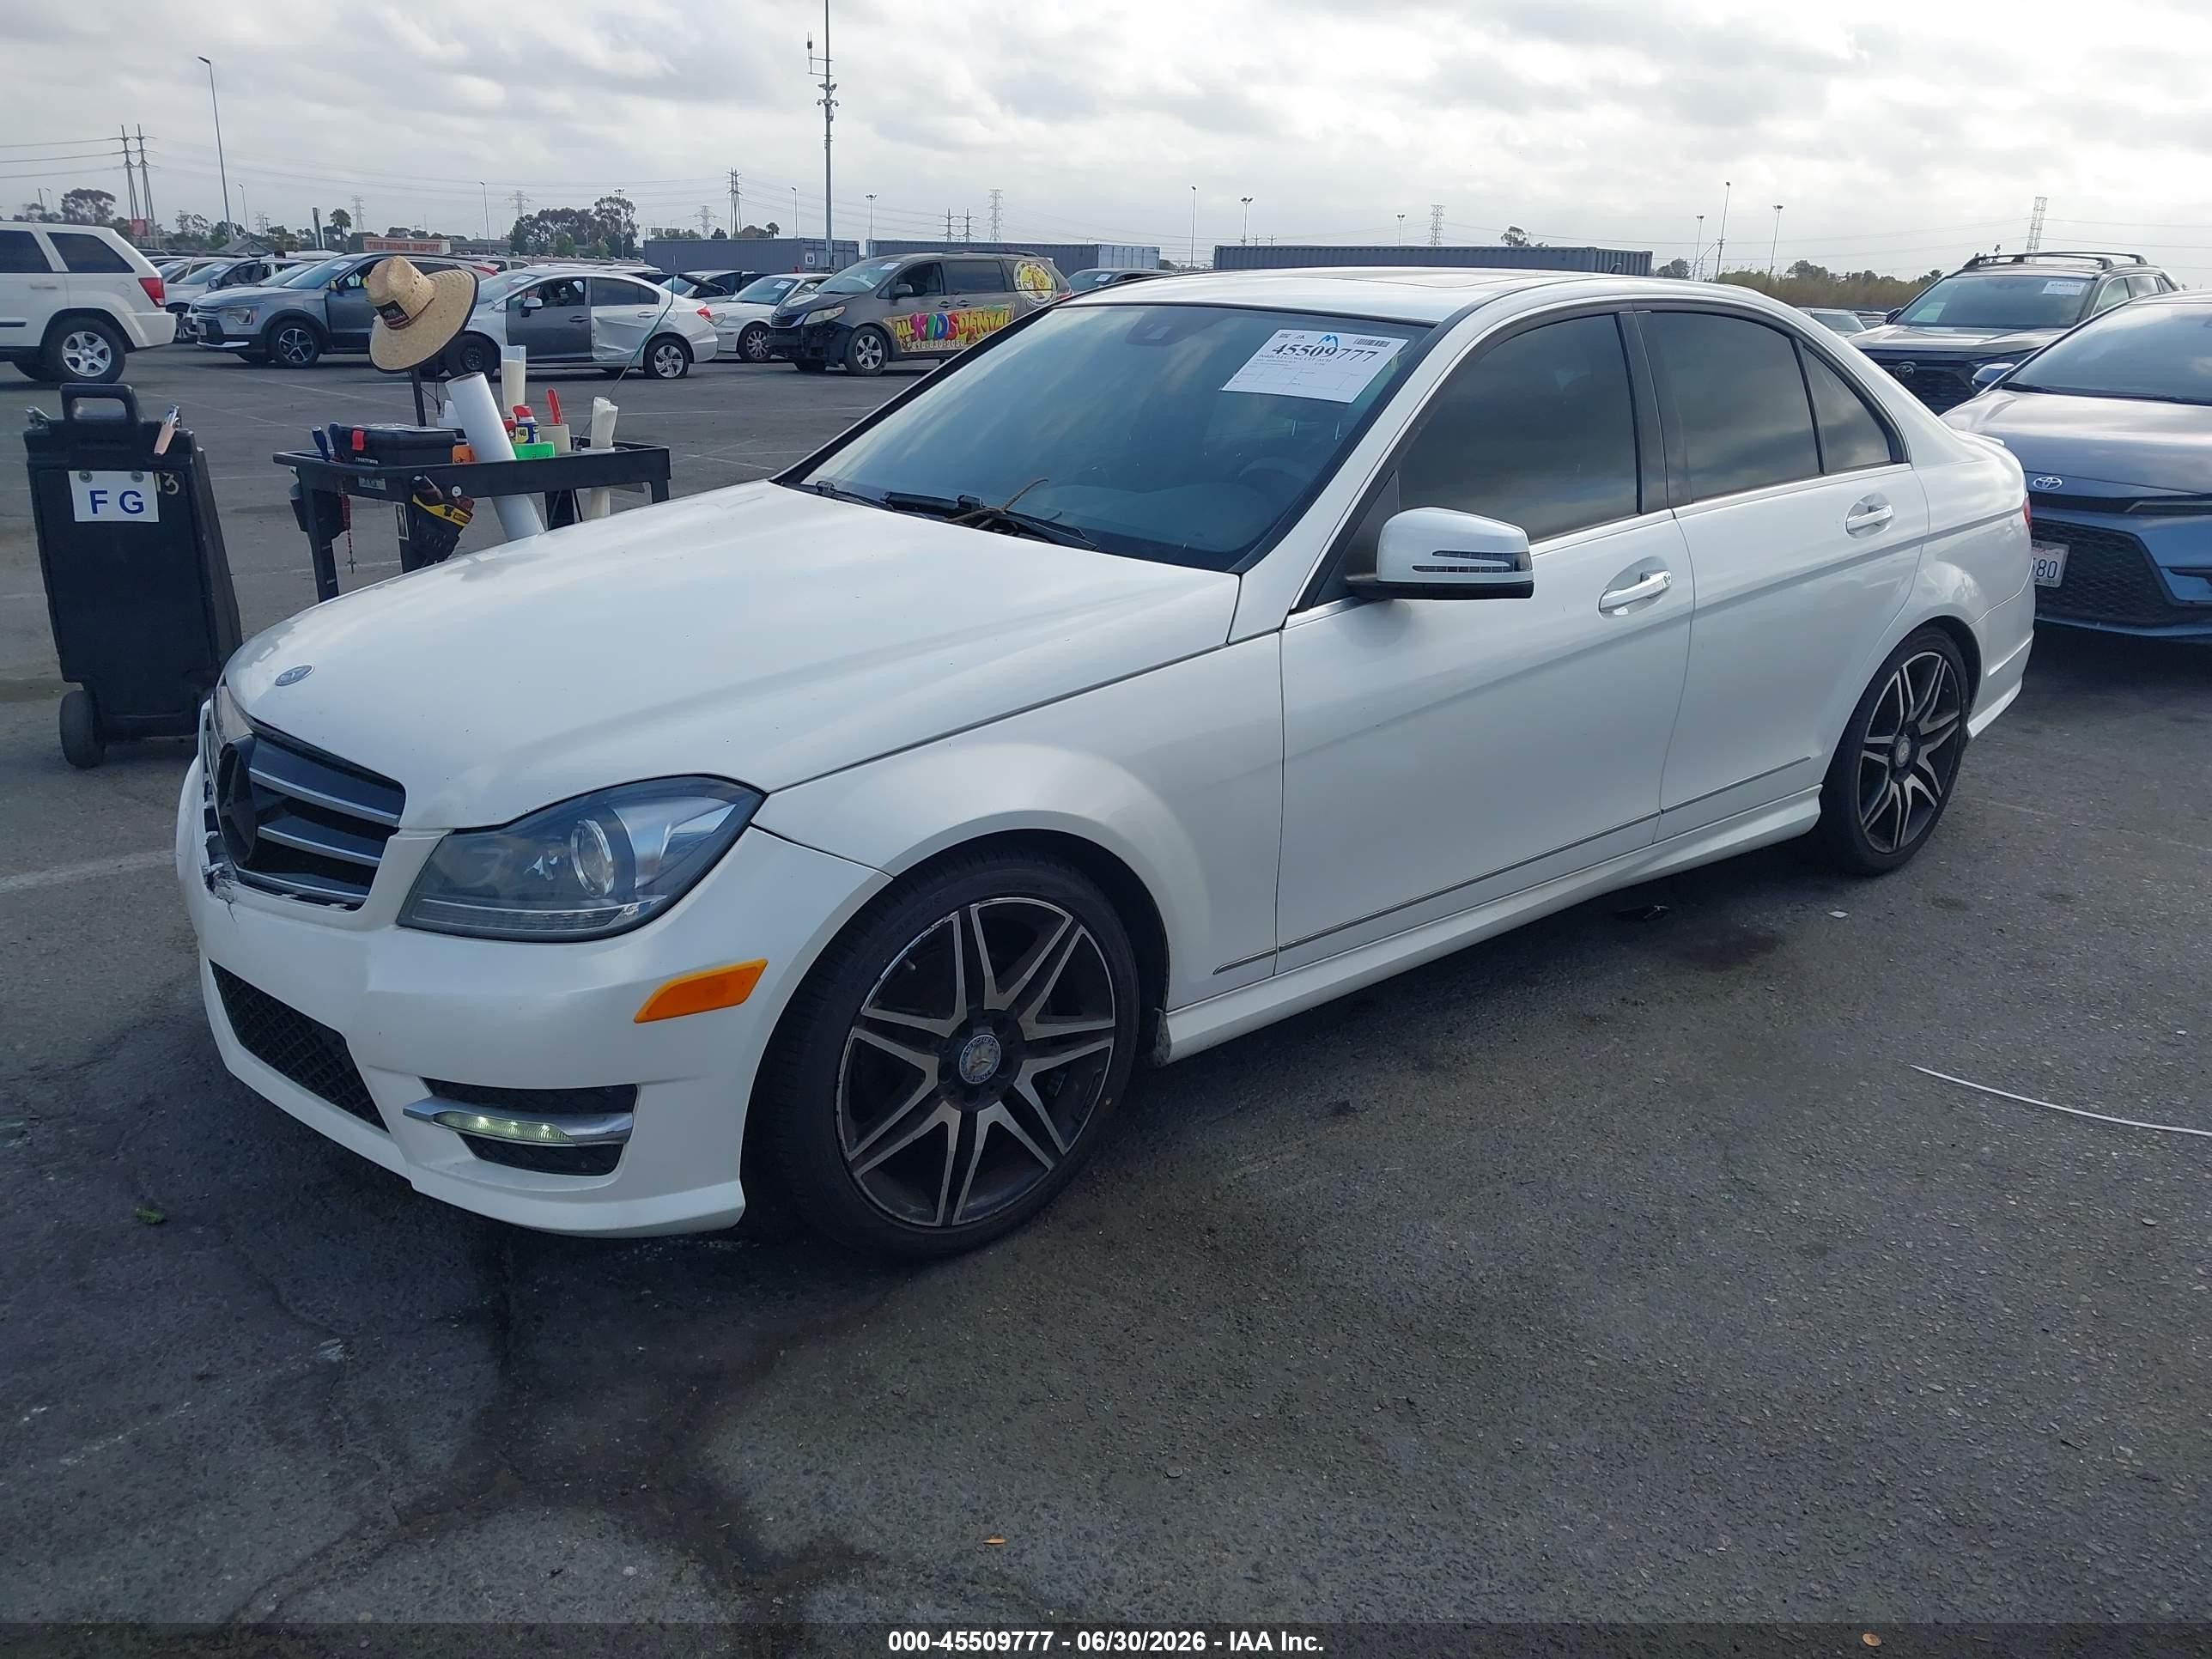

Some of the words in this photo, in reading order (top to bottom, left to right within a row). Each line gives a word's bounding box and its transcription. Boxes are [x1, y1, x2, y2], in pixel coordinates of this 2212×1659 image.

[909, 313, 960, 342] KIDS
[957, 309, 1012, 334] DENTAL
[1272, 343, 1380, 362] 45509777
[89, 490, 108, 514] F
[118, 490, 144, 514] G
[2033, 557, 2057, 579] 80
